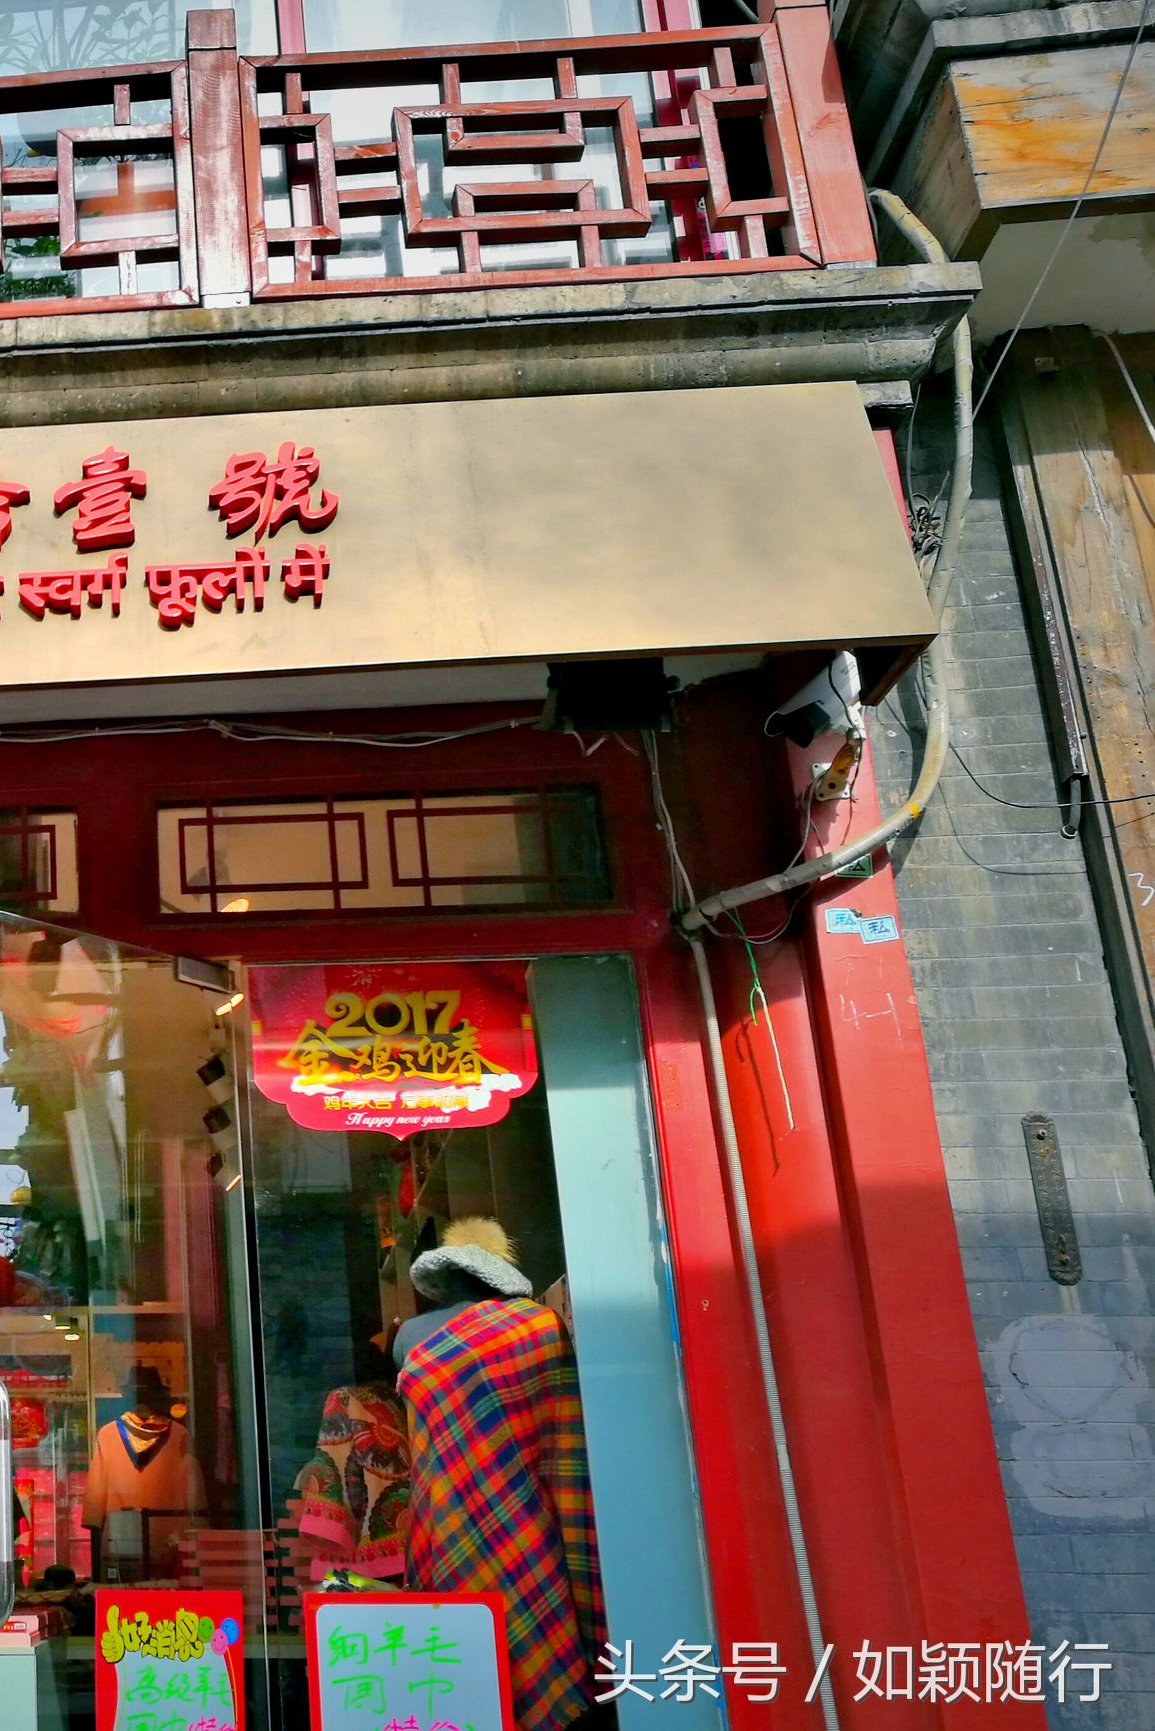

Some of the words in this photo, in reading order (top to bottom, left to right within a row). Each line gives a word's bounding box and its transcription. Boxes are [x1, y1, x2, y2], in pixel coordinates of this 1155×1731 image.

[19, 553, 129, 620] स्वर्ग
[146, 547, 270, 630] फूलों
[282, 544, 331, 607] में
[325, 989, 461, 1037] 2017
[277, 1018, 512, 1086] 金鸡迎春
[345, 1111, 395, 1128] Happy
[395, 1116, 421, 1126] new
[421, 1115, 451, 1127] year
[119, 1608, 206, 1662] 好消息
